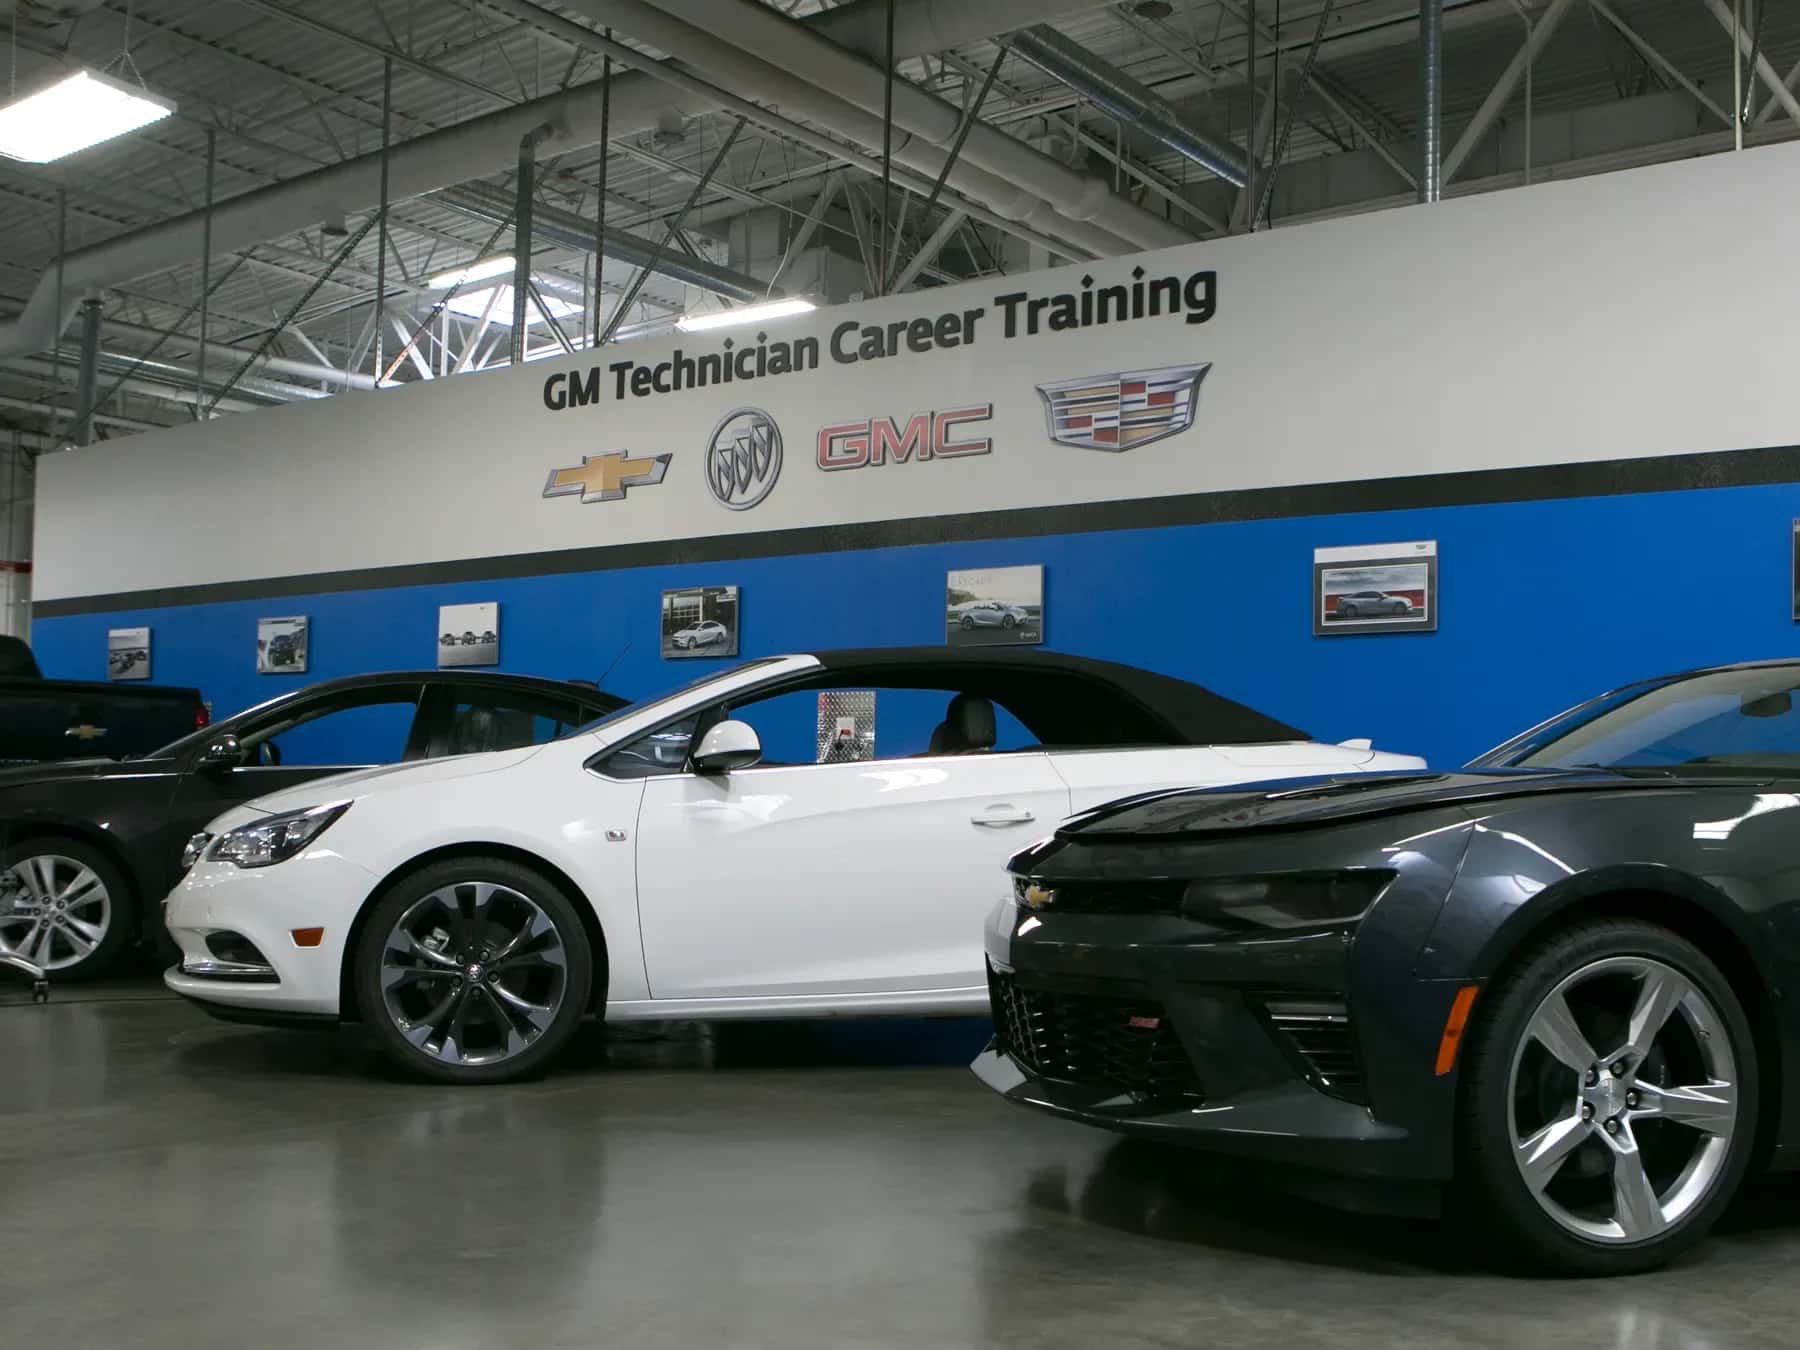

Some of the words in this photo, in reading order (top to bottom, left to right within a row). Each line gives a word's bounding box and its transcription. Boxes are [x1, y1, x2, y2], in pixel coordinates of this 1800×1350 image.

[543, 367, 601, 412] GM
[608, 331, 819, 401] Technician
[830, 307, 985, 366] Career
[994, 265, 1217, 339] Training
[816, 403, 993, 473] GMC
